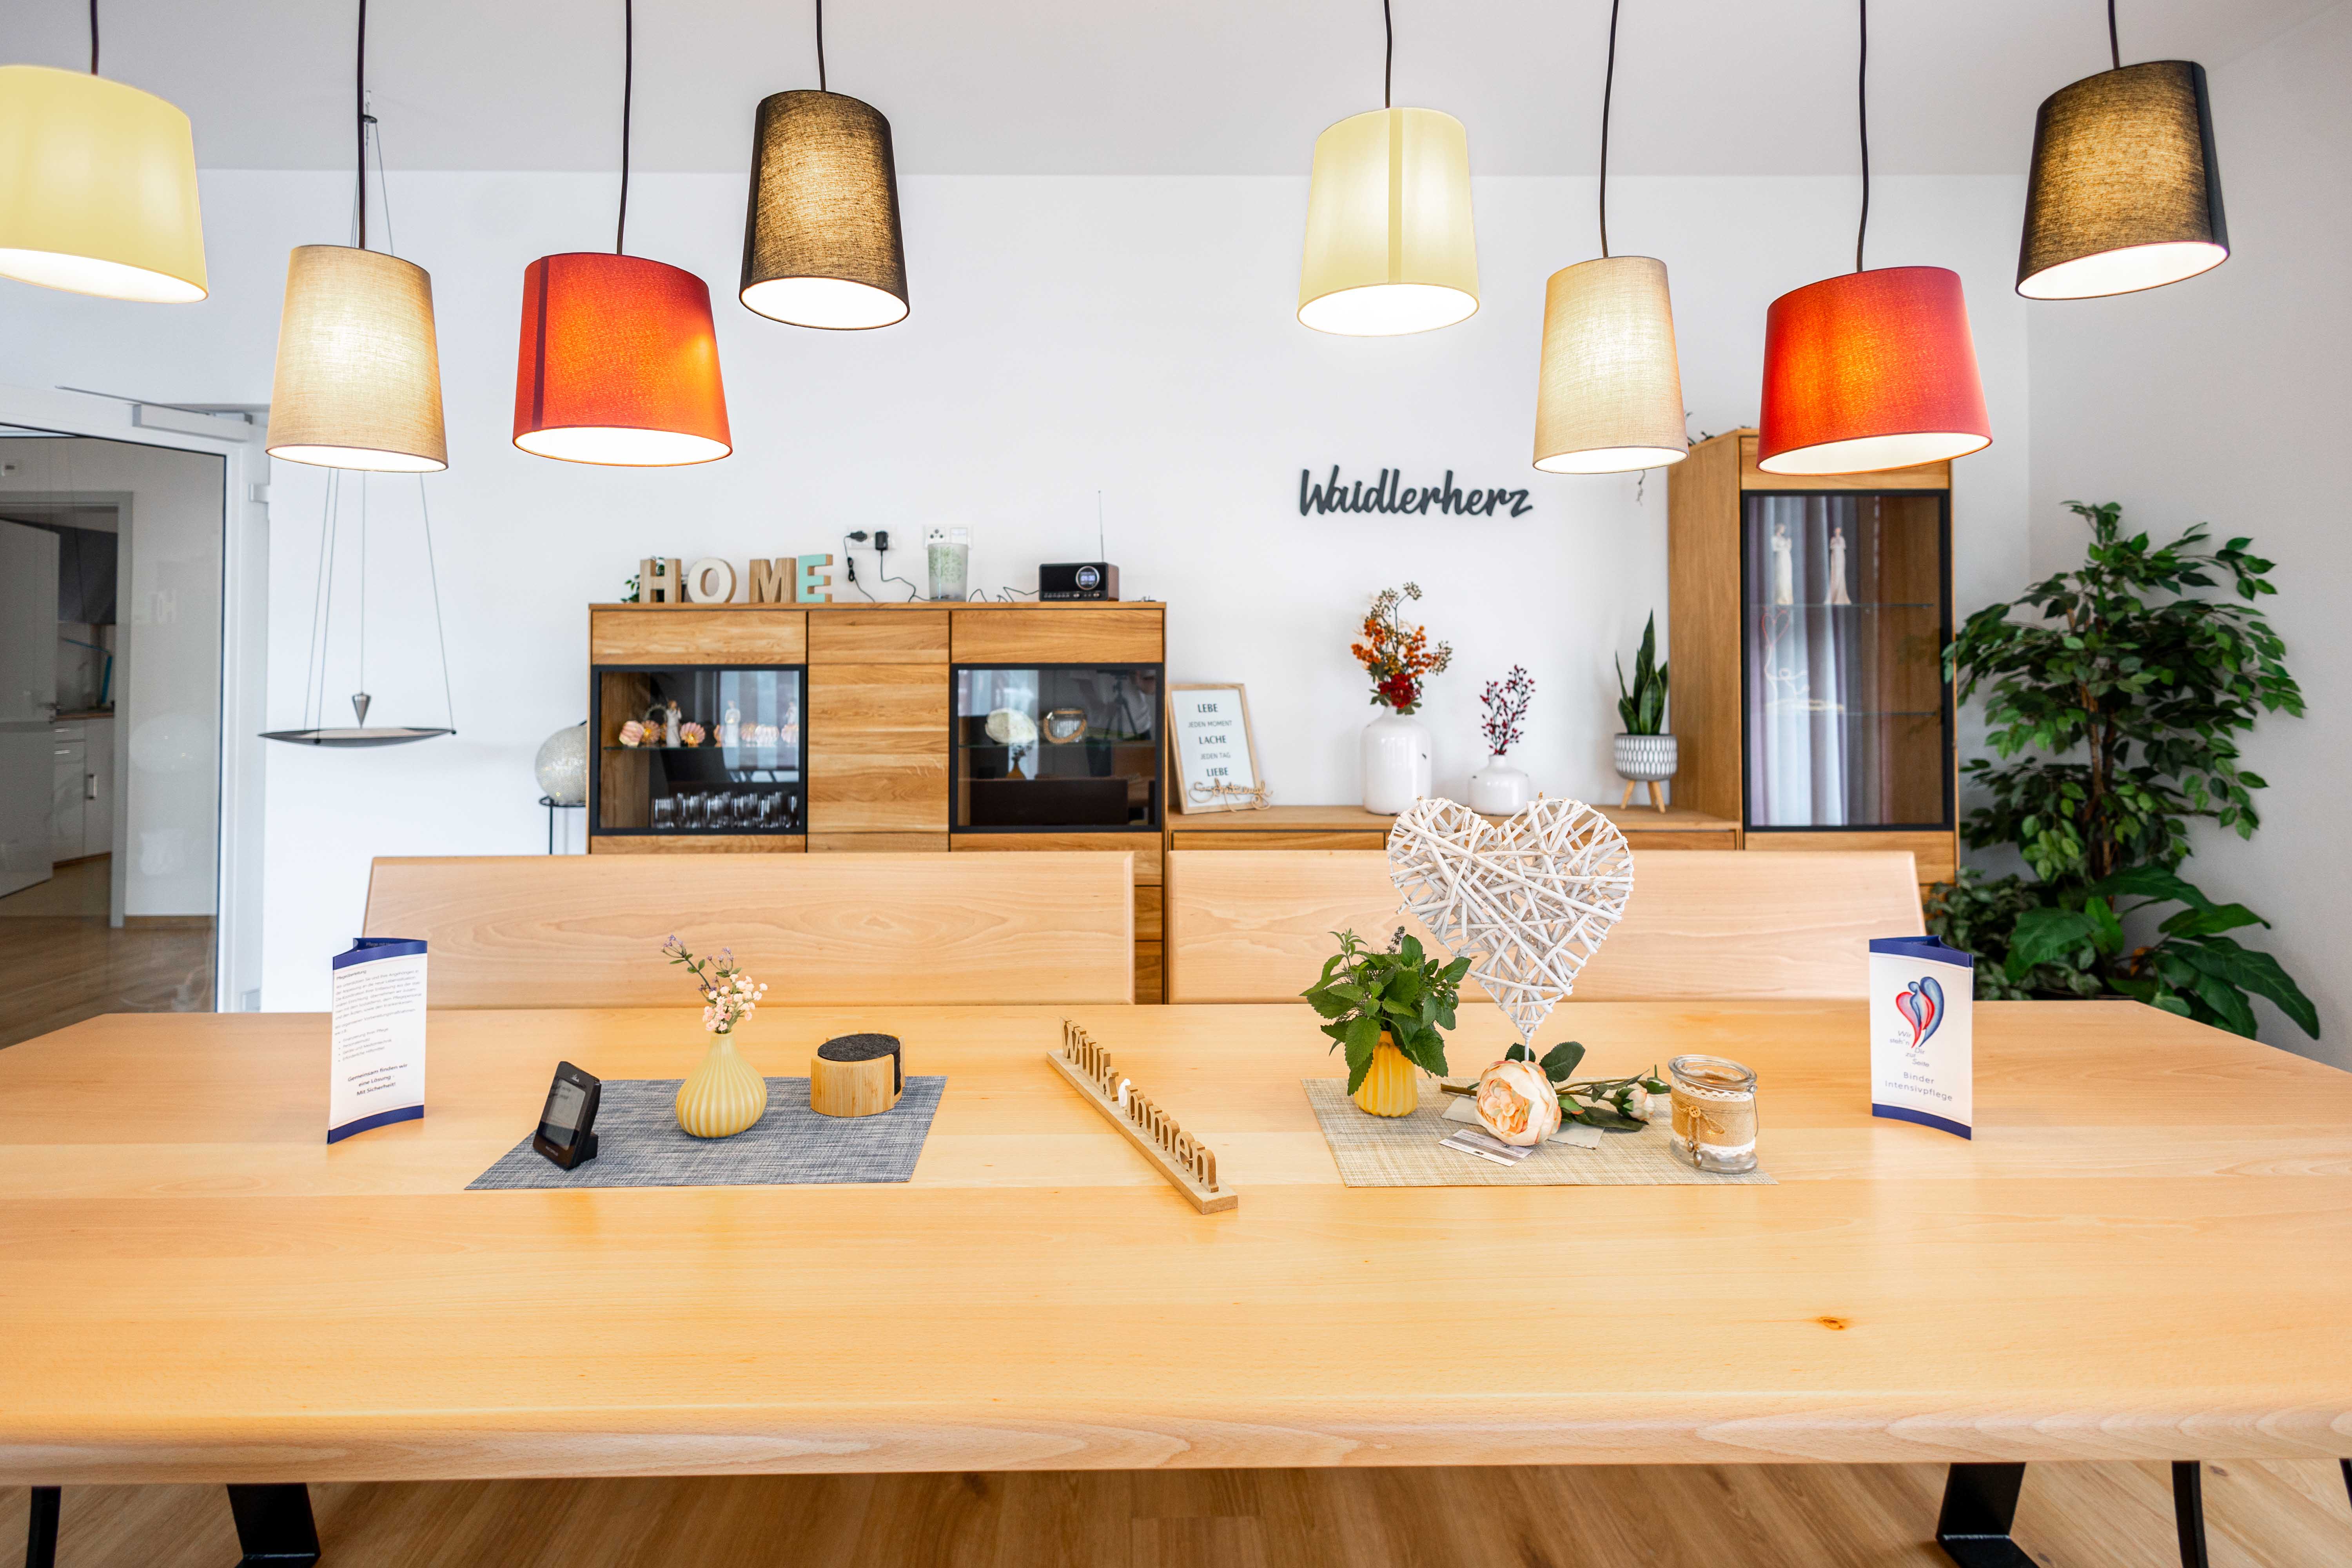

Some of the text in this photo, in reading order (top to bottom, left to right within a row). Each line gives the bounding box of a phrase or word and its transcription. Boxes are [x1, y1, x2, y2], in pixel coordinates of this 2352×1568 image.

[1300, 465, 1533, 517] Waidlerherz
[639, 554, 833, 603] HOME
[1198, 703, 1218, 713] LEBE
[1199, 735, 1227, 744] LACHE
[1206, 767, 1229, 777] LIEBE
[348, 1070, 379, 1082] Gemeinsam
[1903, 1072, 1935, 1084] Binder
[367, 1082, 396, 1093] Sicherheit!
[1885, 1080, 1953, 1101] Intensivpflege
